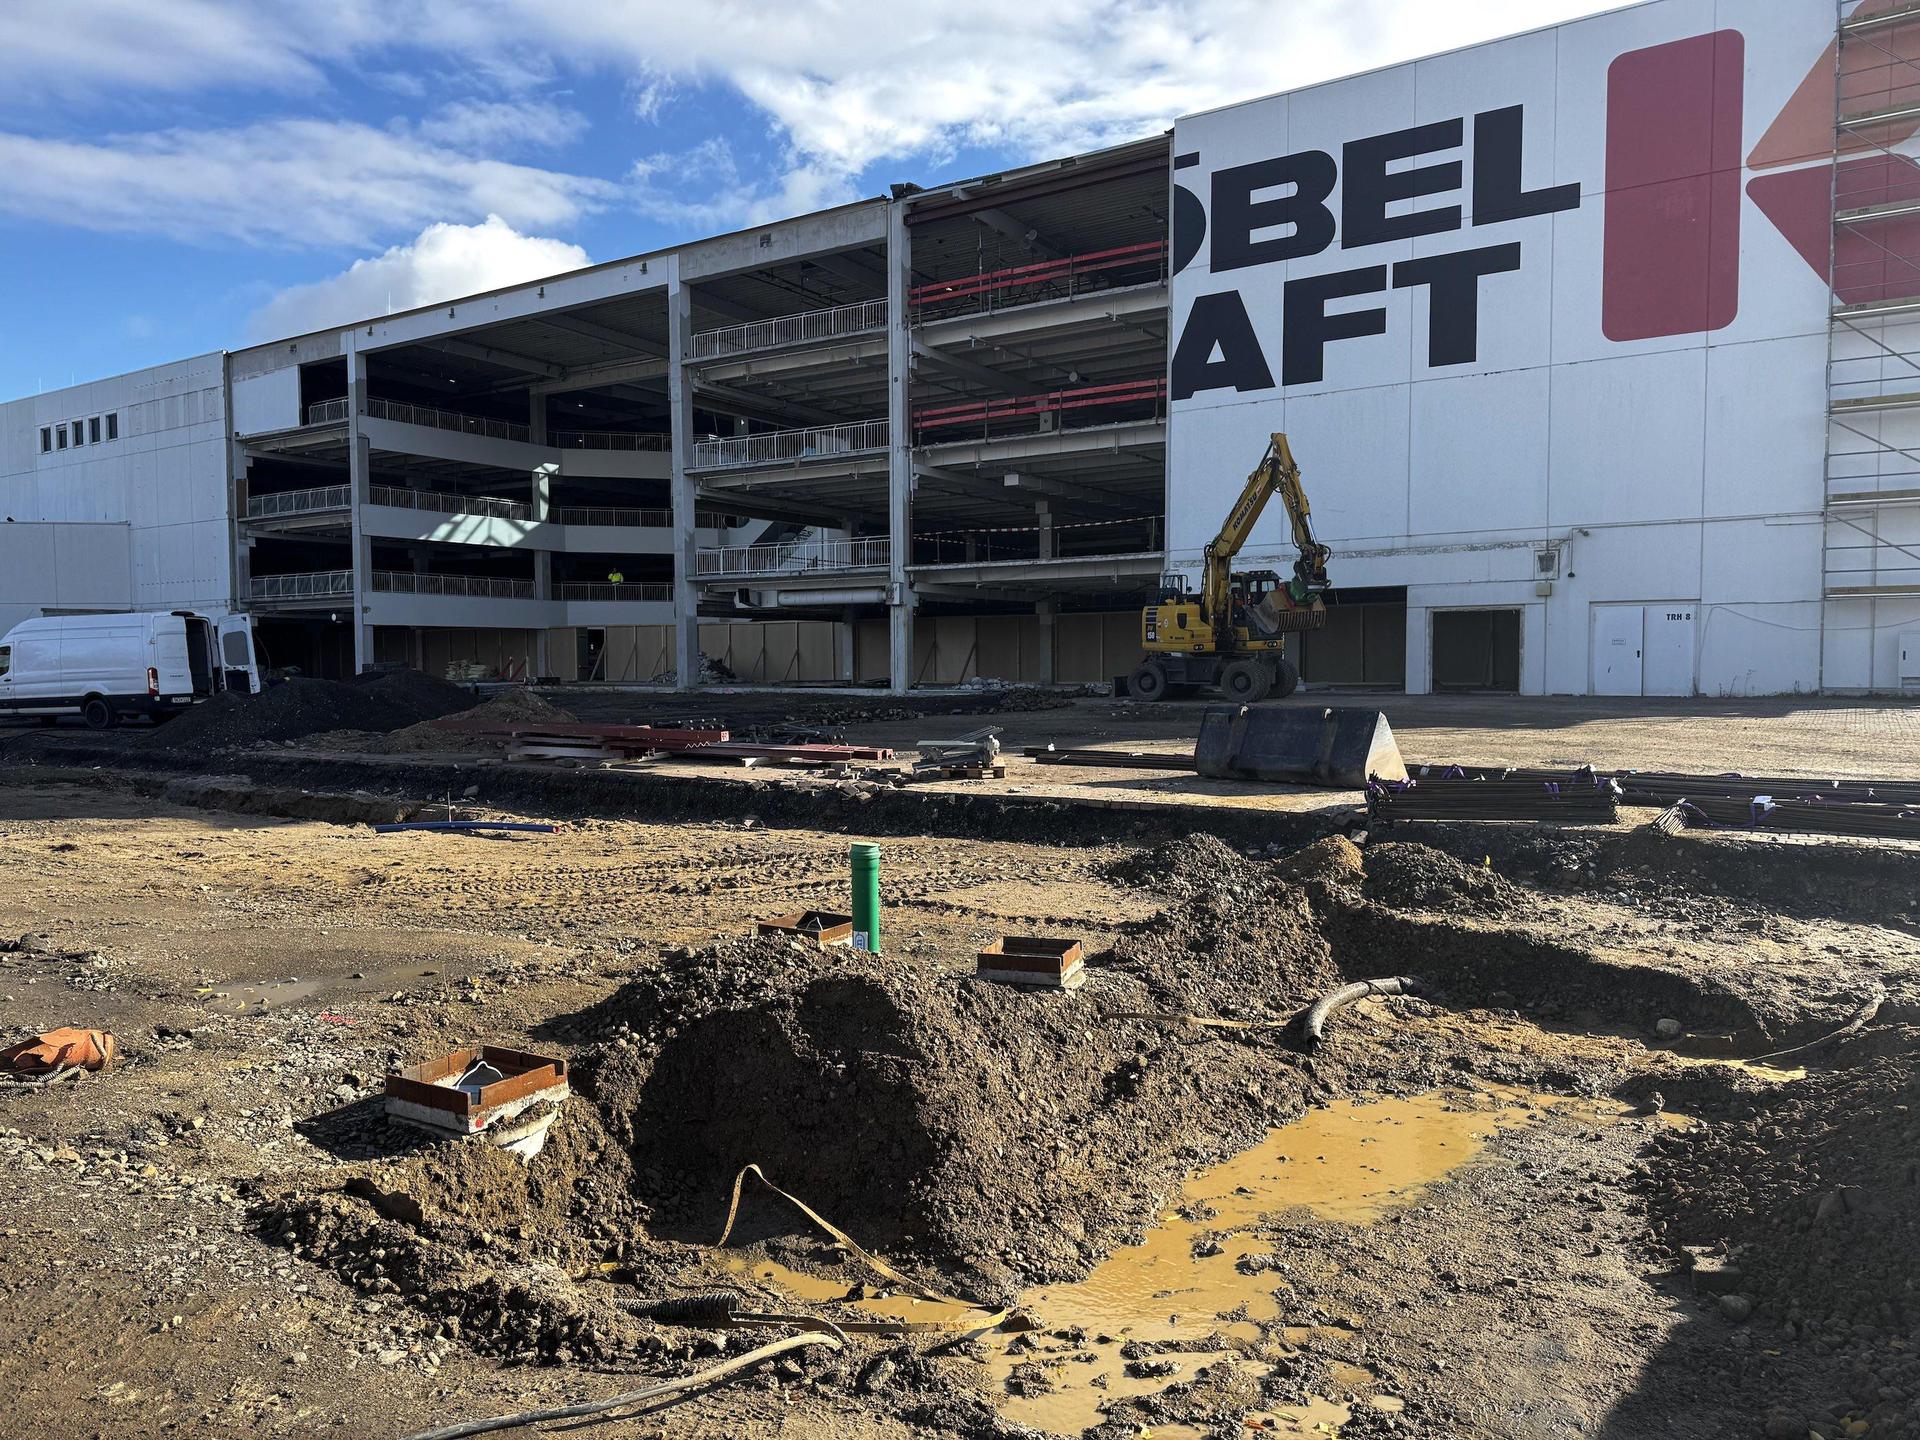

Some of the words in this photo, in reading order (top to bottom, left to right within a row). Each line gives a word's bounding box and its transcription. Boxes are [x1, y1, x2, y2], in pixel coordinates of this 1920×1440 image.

[1173, 104, 1581, 277] BEL
[1172, 241, 1521, 400] AFT
[1233, 491, 1257, 530] KOMATSU
